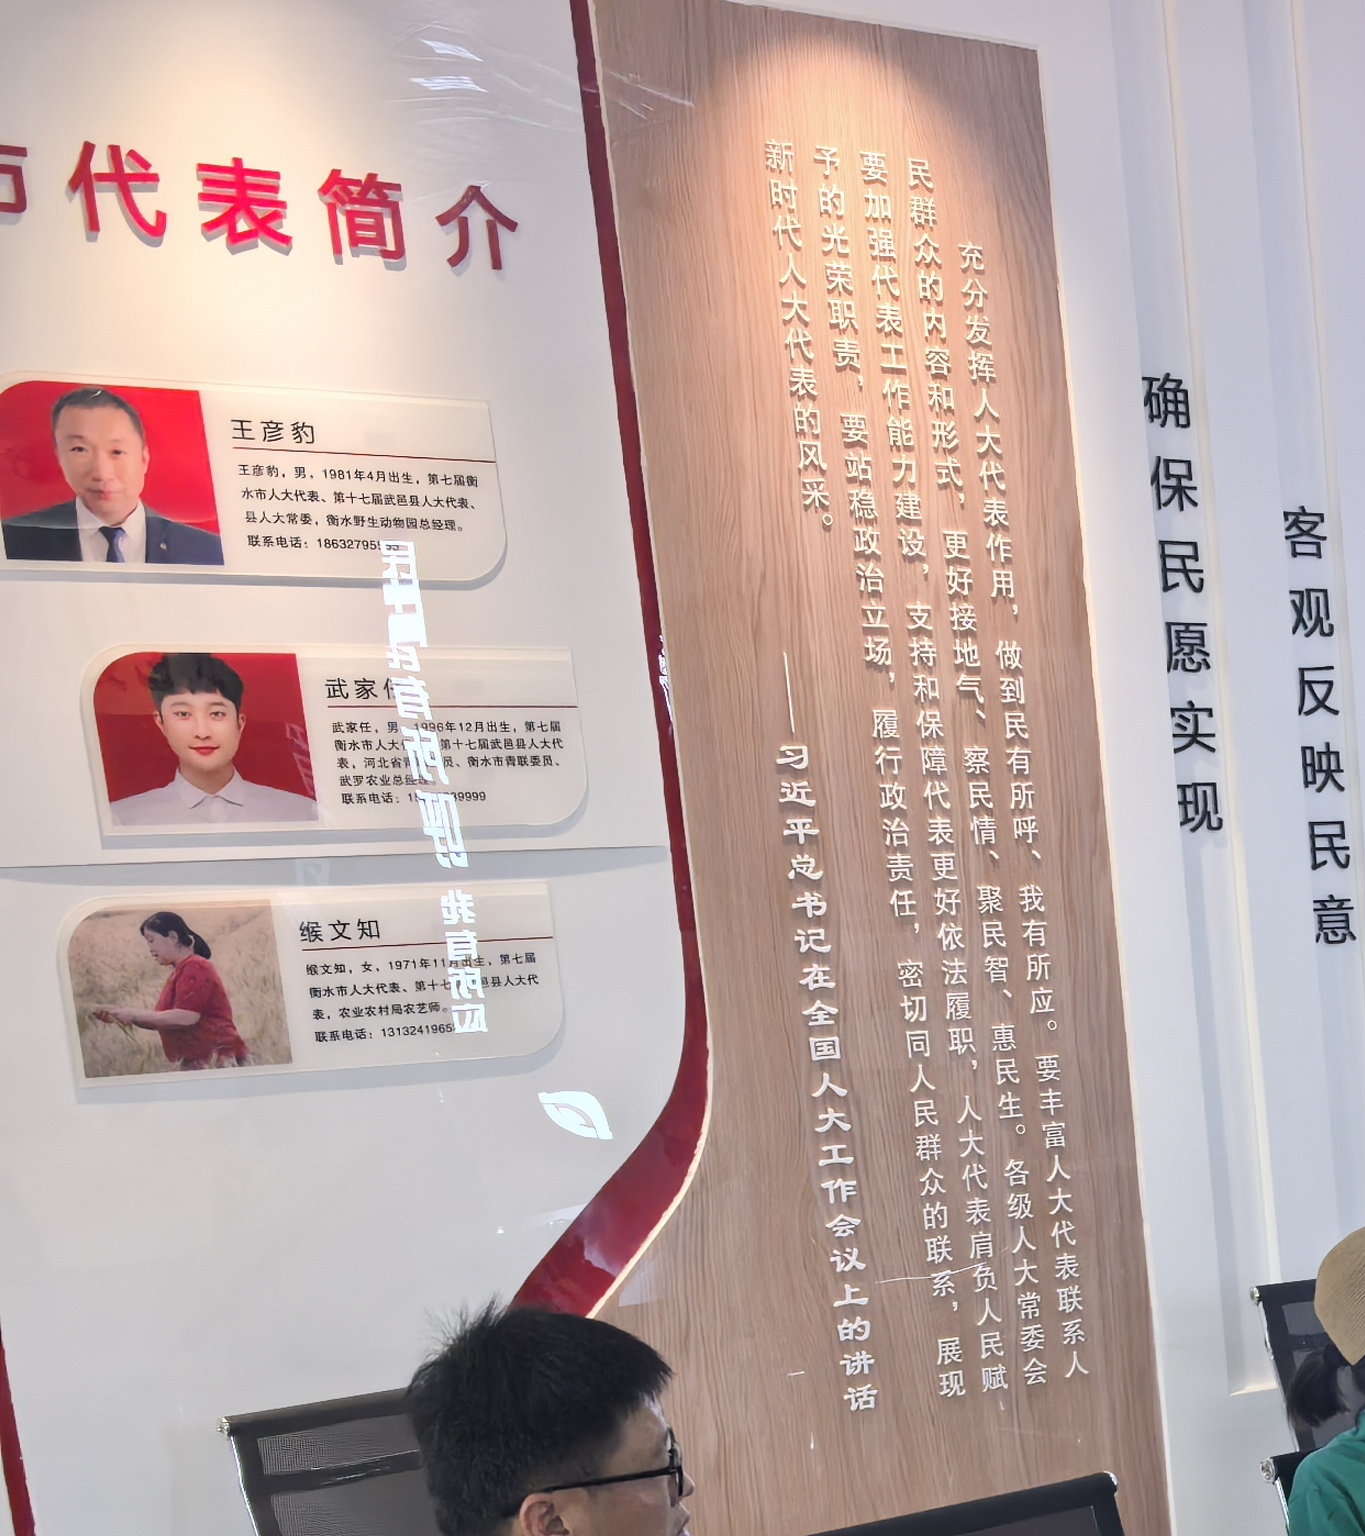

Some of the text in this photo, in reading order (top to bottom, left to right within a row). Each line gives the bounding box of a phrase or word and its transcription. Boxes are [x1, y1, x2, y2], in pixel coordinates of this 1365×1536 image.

[230, 418, 316, 446] 王彦豹
[1141, 372, 1223, 834] 确保民愿实现
[1283, 505, 1357, 946] 客观反映民意
[314, 1021, 457, 1044] 联系电话：1313241965
